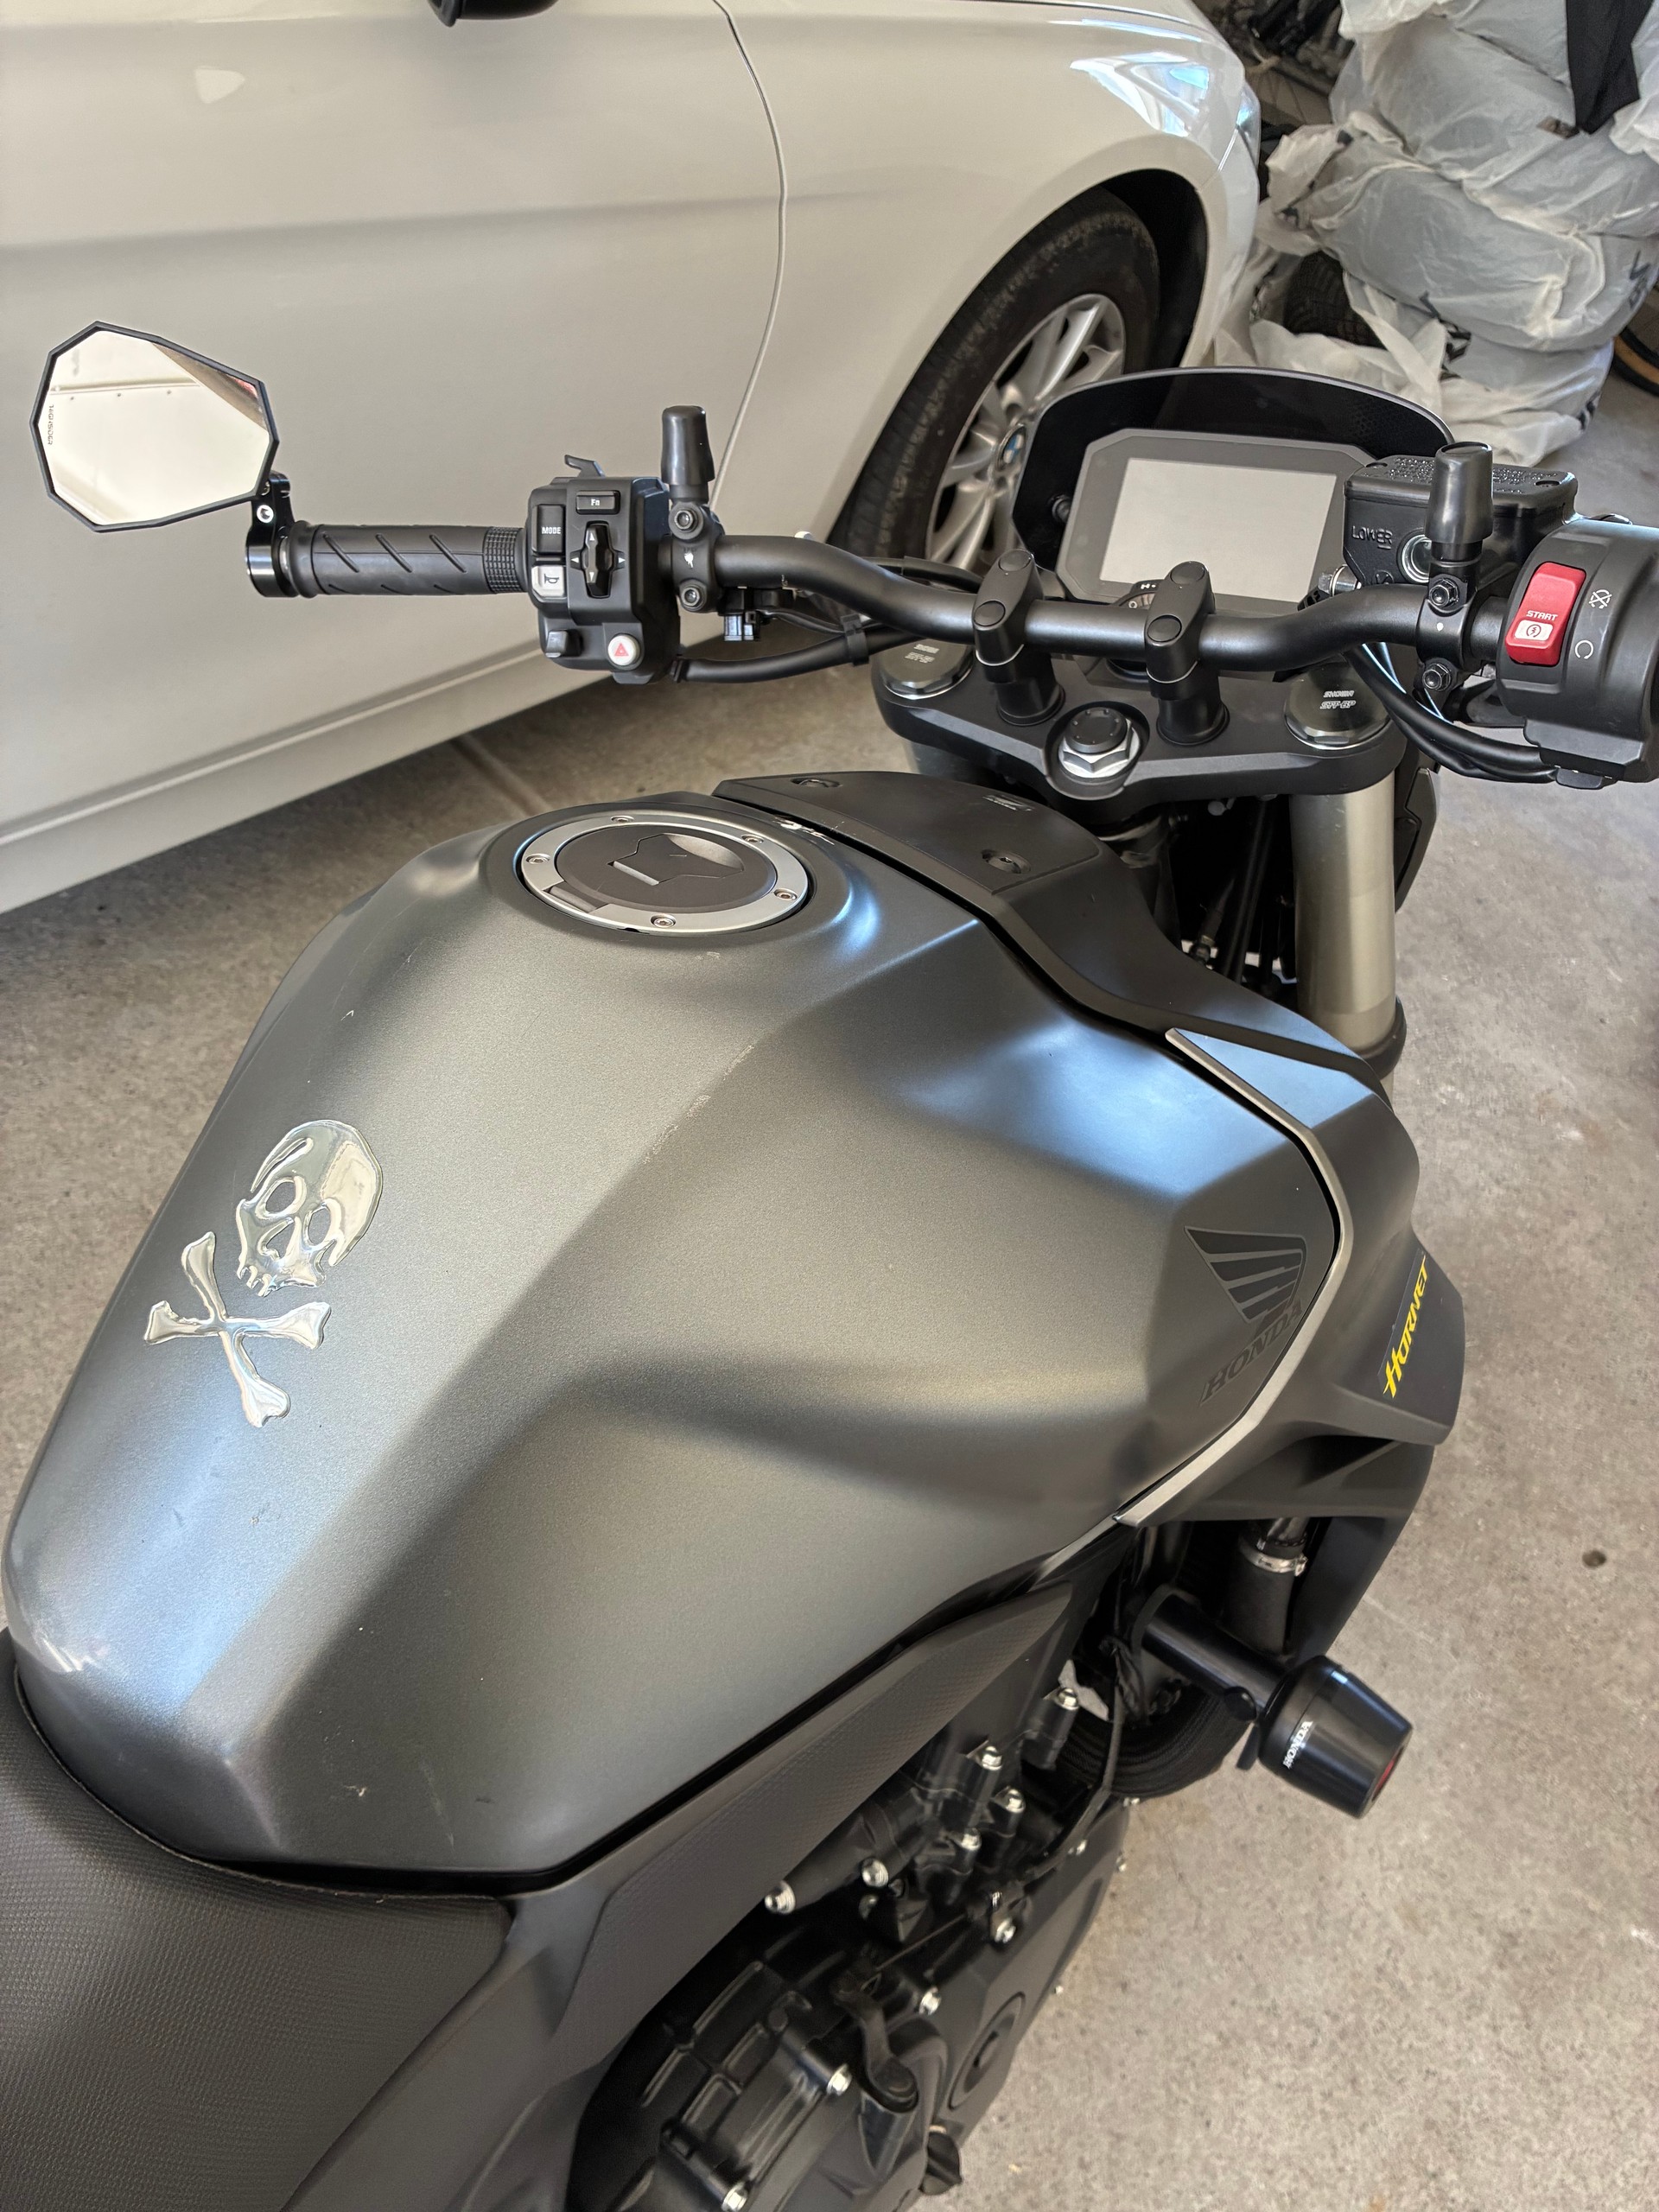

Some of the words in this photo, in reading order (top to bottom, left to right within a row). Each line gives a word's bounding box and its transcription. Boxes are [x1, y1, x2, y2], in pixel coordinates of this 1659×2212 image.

[541, 526, 562, 535] MODE
[1351, 524, 1393, 545] LOWER
[1526, 610, 1558, 621] START
[1382, 1254, 1427, 1398] HORNET
[1282, 1720, 1313, 1770] HONDA
